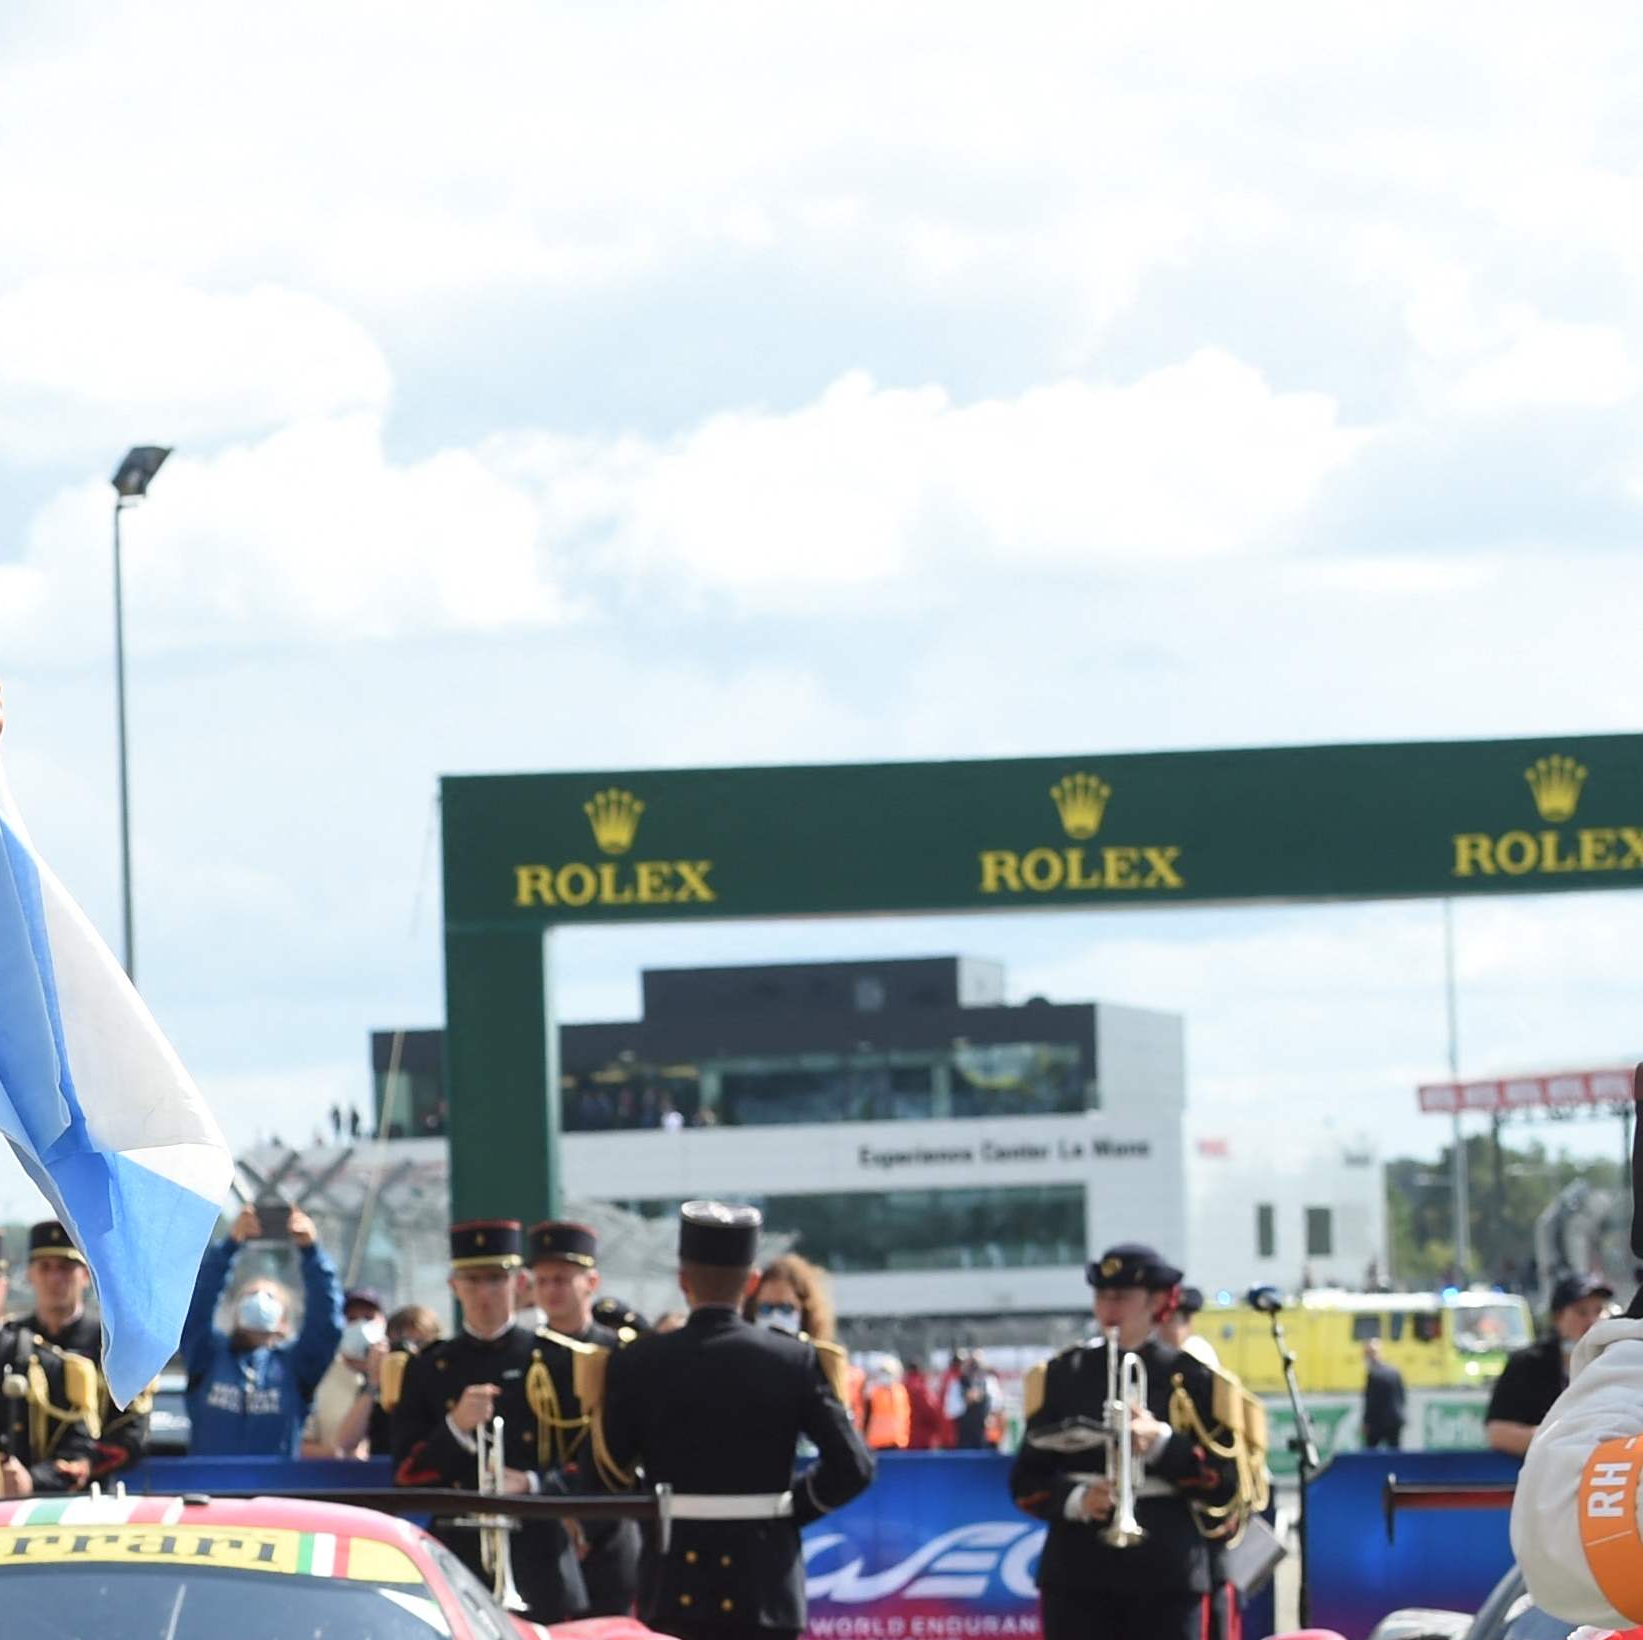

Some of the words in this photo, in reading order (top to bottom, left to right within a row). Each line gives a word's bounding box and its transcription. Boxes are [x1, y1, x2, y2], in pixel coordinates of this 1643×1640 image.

[512, 861, 715, 909] ROLEX
[977, 845, 1183, 896] ROLEX
[980, 1139, 1049, 1163] Center
[1058, 1139, 1083, 1160] Le
[810, 1614, 907, 1637] WORLD
[911, 1613, 1040, 1637] ENDURAN
